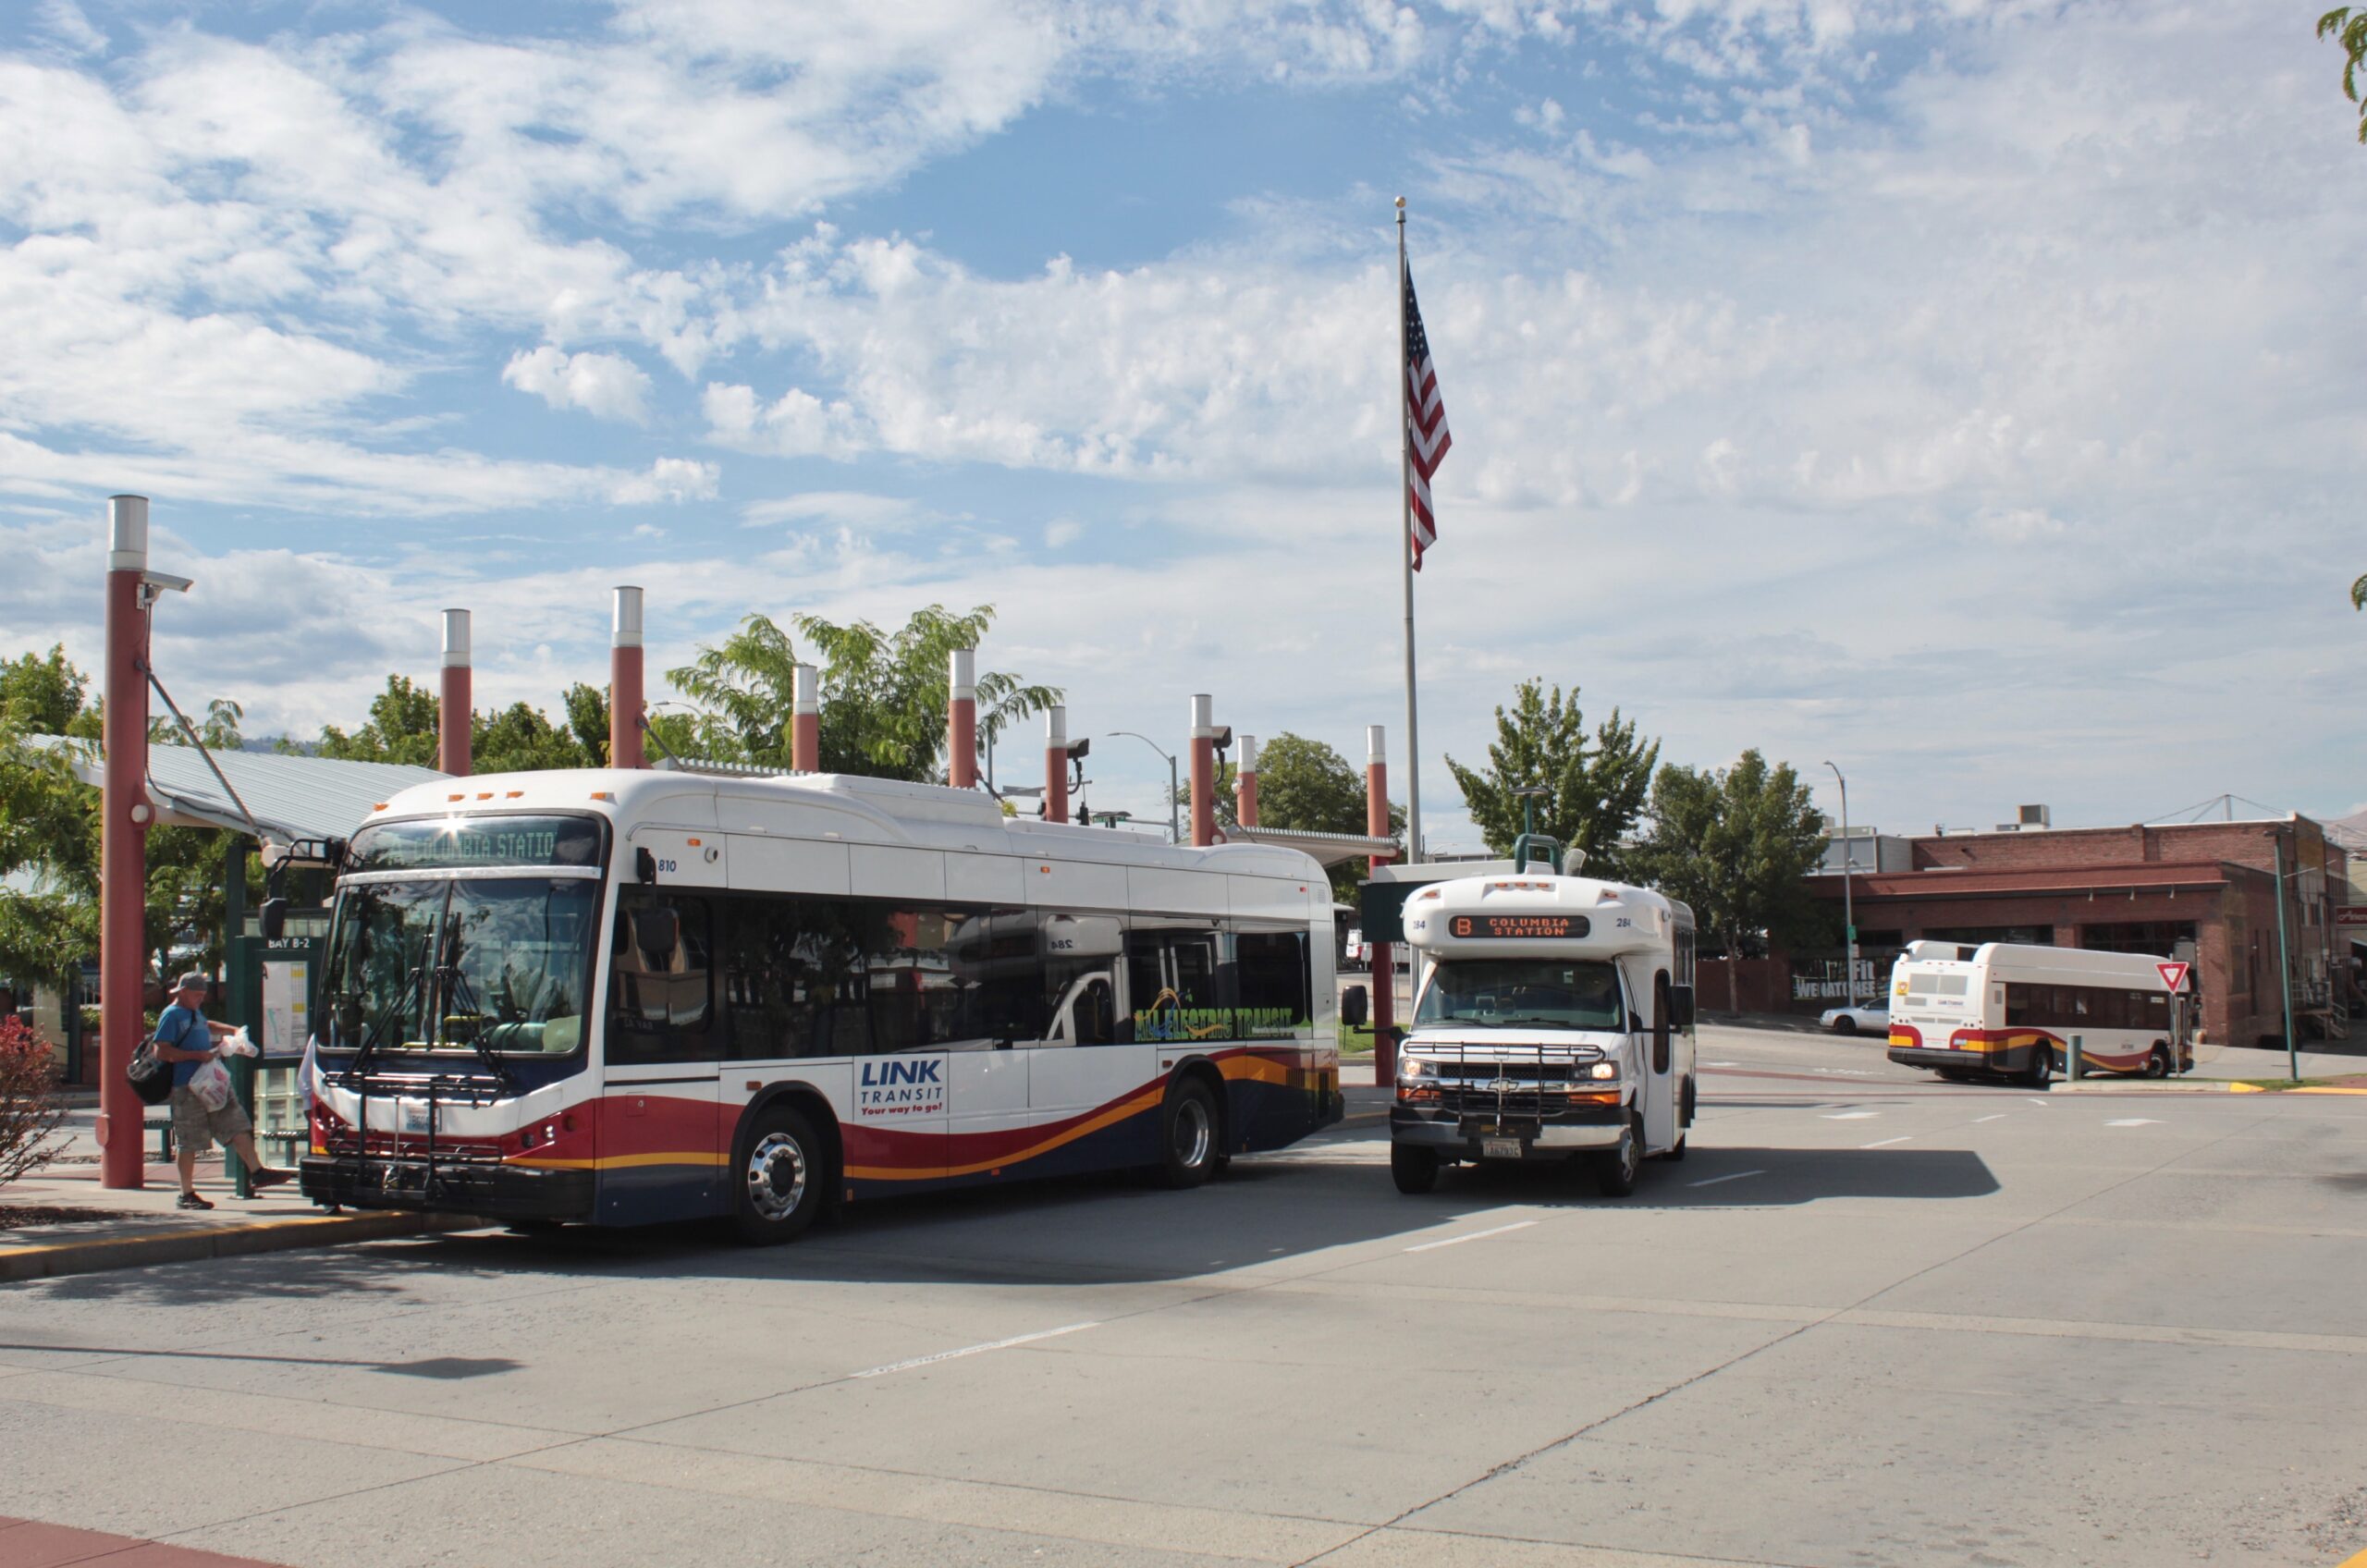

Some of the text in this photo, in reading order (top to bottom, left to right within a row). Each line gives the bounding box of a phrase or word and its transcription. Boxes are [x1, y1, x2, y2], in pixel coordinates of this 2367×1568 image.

[414, 834, 490, 860] COLUMBIA
[497, 831, 558, 859] STATIO
[658, 859, 677, 872] 810
[1457, 918, 1472, 936] B
[1490, 918, 1569, 927] COLUMBIA
[1616, 918, 1631, 927] 284
[1494, 927, 1564, 936] STATION
[268, 937, 310, 949] BAY B-2
[1135, 1008, 1293, 1041] ALL ELECTRIC TRANSIT
[861, 1060, 942, 1086] LINK
[861, 1087, 942, 1104] TRANSIT
[862, 1102, 942, 1116] Your way to go!
